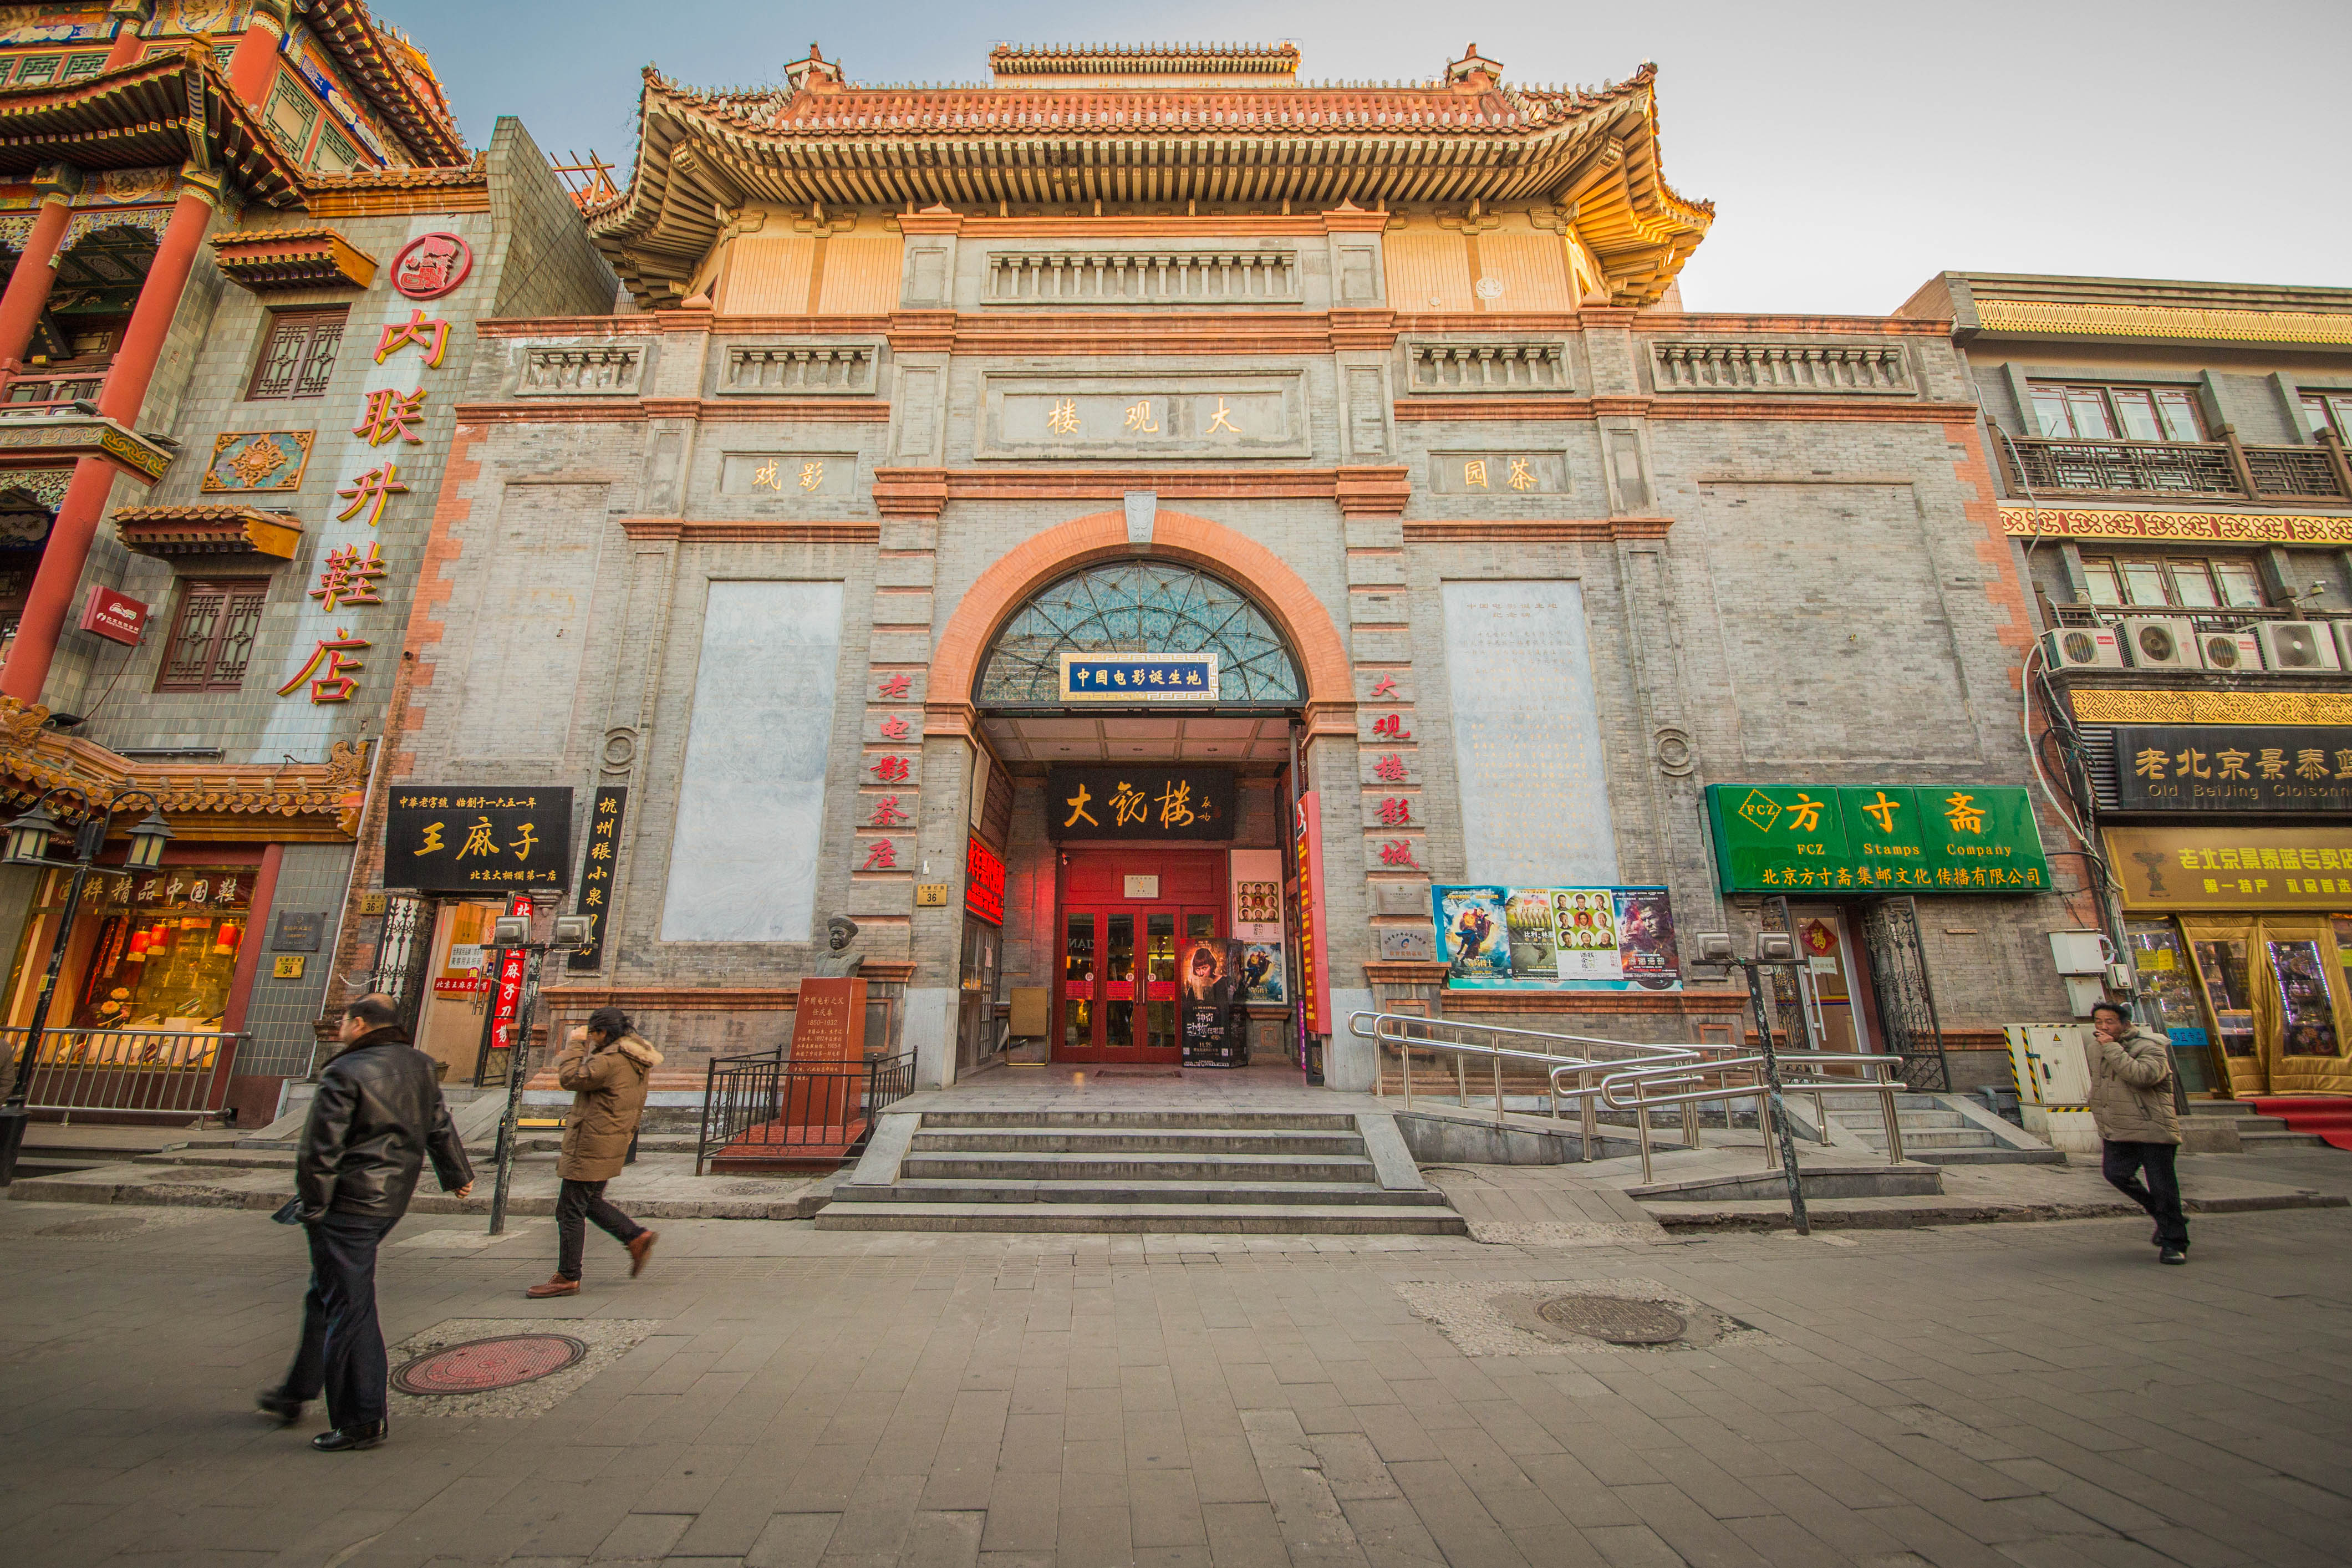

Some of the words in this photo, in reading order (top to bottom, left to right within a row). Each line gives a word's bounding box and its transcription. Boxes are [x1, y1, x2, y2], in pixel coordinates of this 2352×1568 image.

[277, 309, 452, 705] 内联升鞋店
[1077, 668, 1202, 687] 中国电影诞生地
[863, 674, 912, 869] 老电影茶座
[1371, 674, 1419, 869] 大观楼影城
[2149, 784, 2178, 797] Old
[2273, 784, 2352, 797] Cloisonn
[1747, 805, 1776, 816] FCZ
[1786, 791, 1986, 834] 方寸斋
[414, 816, 539, 861] 王麻子
[1797, 843, 1825, 855] FCZ
[1864, 843, 1920, 856] Stamps
[1947, 843, 2012, 857] Company
[1762, 867, 2041, 887] 北京方寸斋集邮文化传播有限公司
[2203, 879, 2268, 893] 第一特产
[2285, 879, 2352, 893] 礼品首选
[927, 893, 936, 902] 36
[366, 903, 383, 912] 36-1
[1811, 928, 1826, 949] 福
[283, 965, 293, 975] 34
